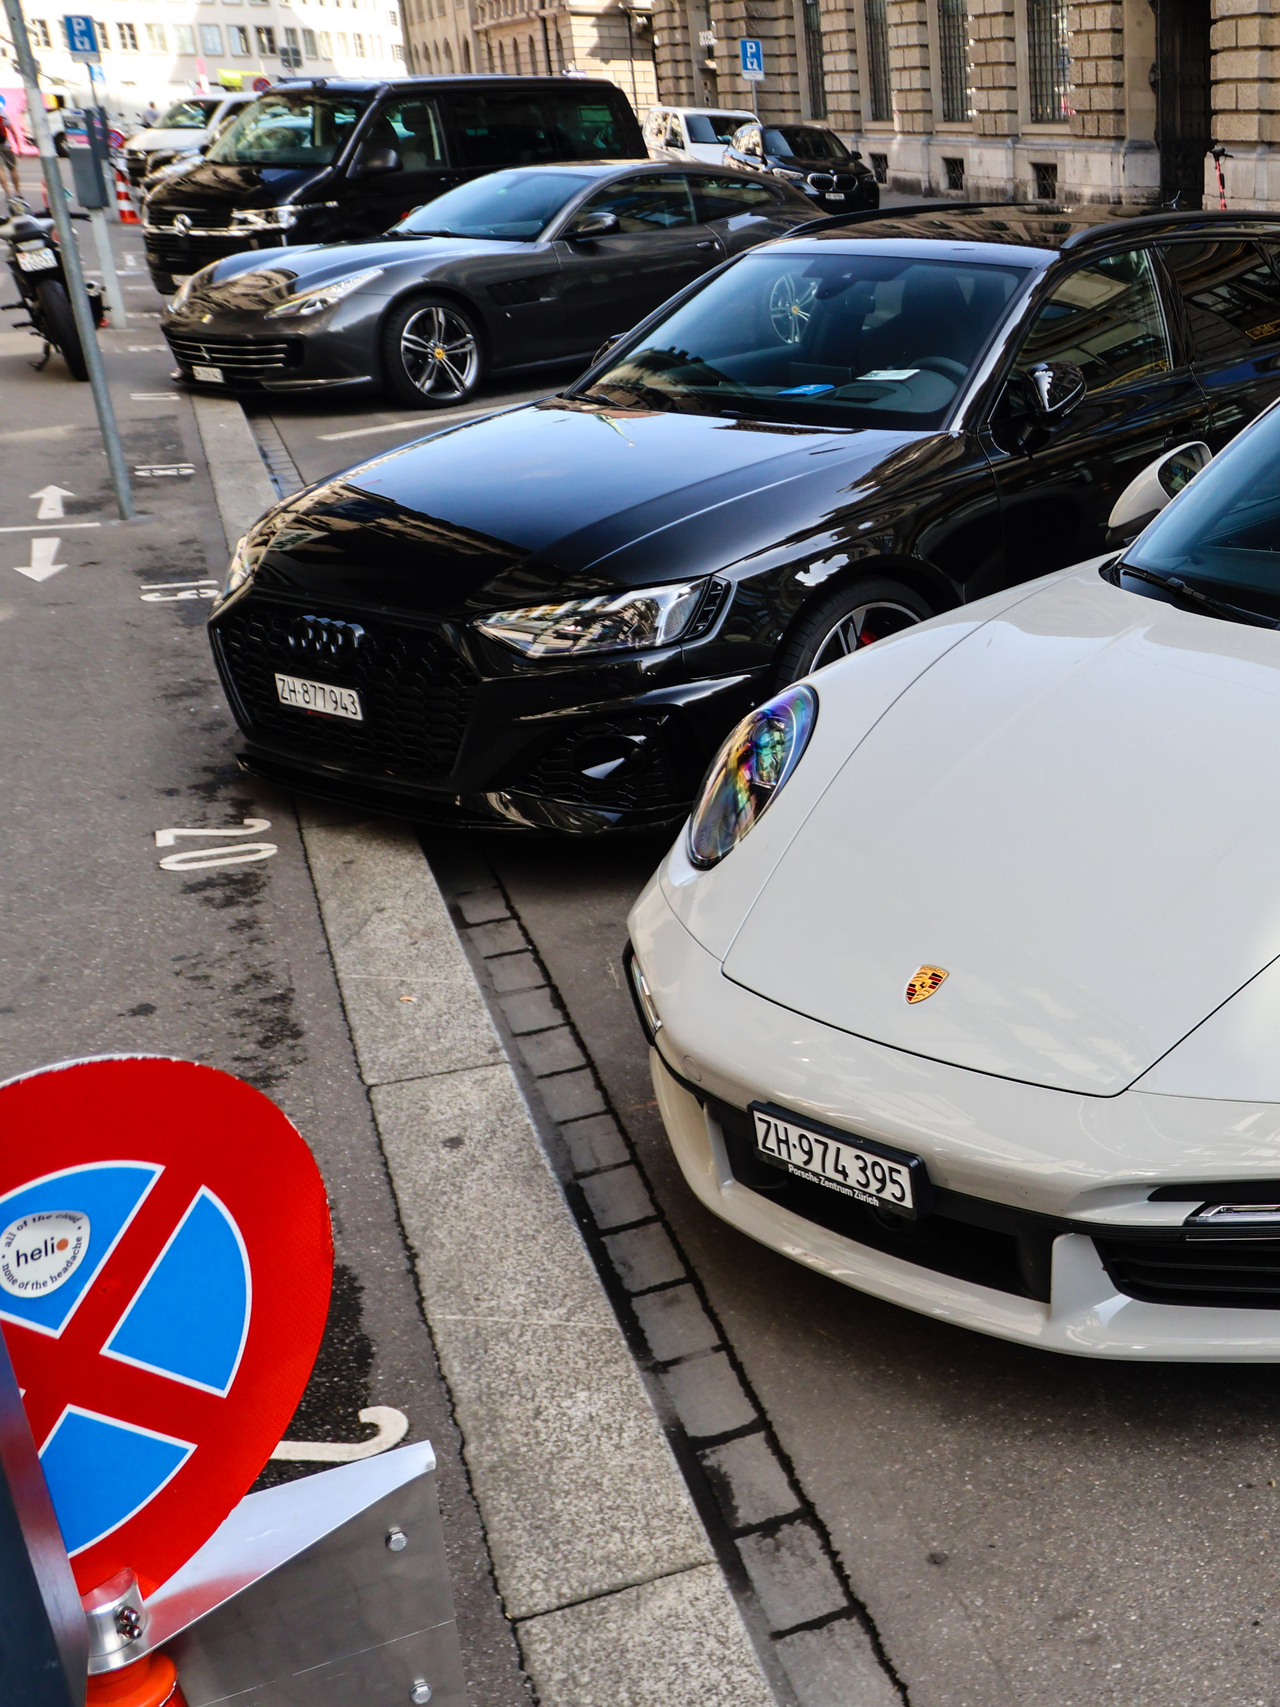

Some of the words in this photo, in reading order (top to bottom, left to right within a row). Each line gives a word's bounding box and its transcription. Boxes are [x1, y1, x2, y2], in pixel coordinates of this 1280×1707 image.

[71, 17, 87, 36] P
[746, 42, 756, 57] P
[155, 818, 278, 871] 20
[788, 1163, 819, 1184] Porsche
[820, 1175, 854, 1198] Zentrum
[853, 1188, 880, 1207] Zürich
[4, 1232, 17, 1248] all
[17, 1220, 28, 1231] of
[32, 1214, 53, 1223] the
[2, 1262, 18, 1285] none
[18, 1280, 30, 1290] of
[31, 1280, 48, 1290] the
[49, 1236, 83, 1284] headache
